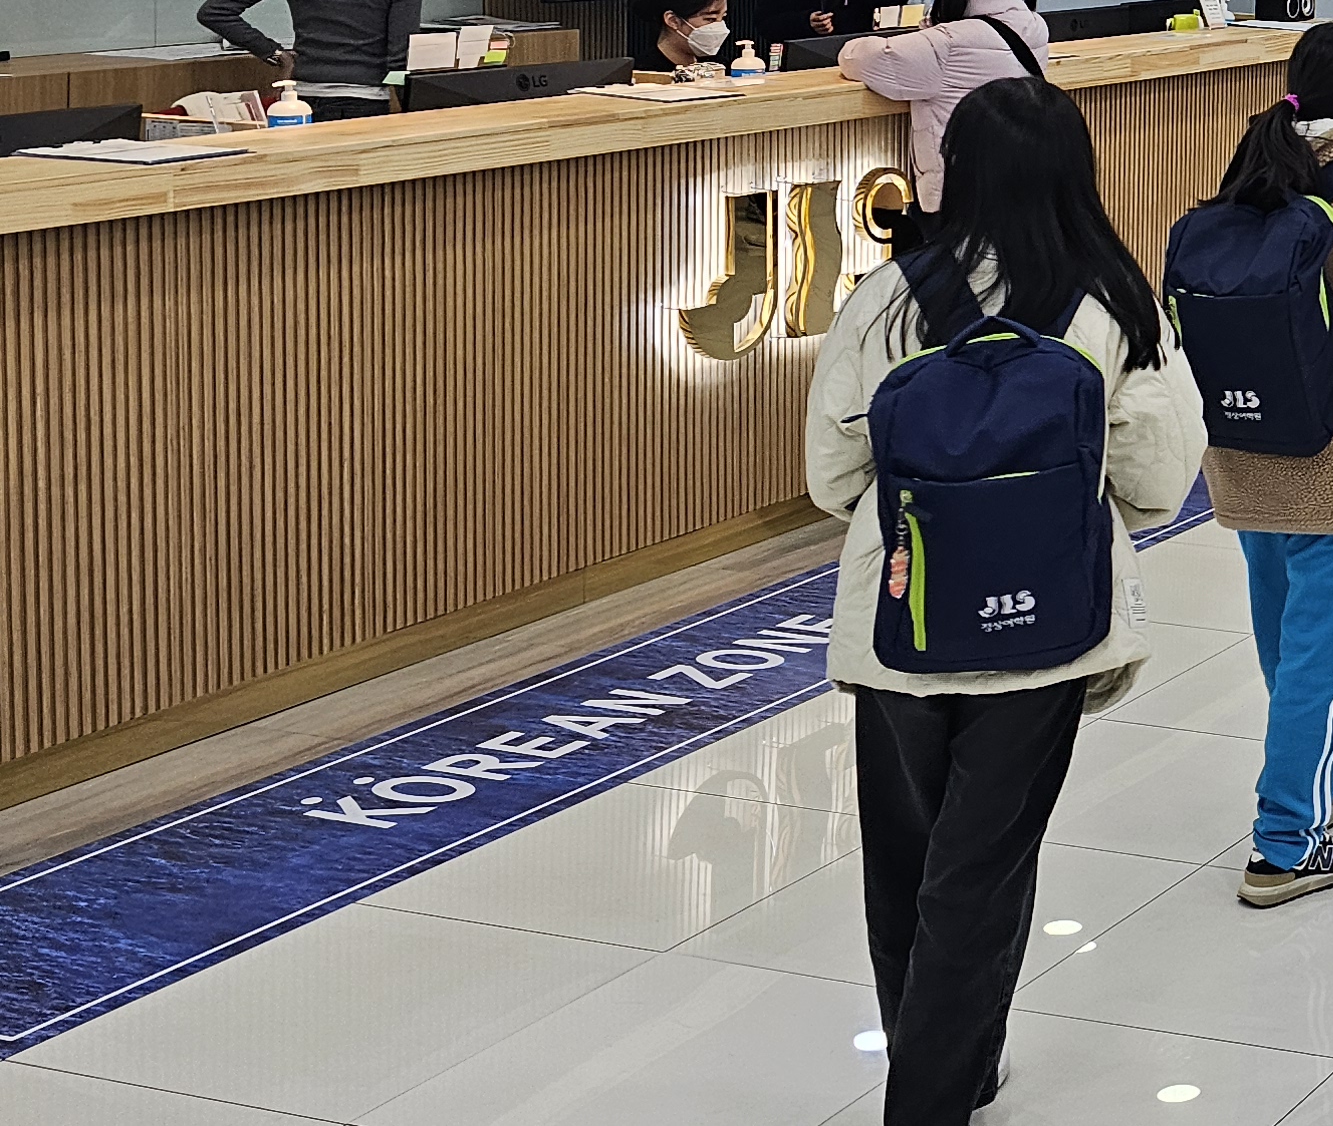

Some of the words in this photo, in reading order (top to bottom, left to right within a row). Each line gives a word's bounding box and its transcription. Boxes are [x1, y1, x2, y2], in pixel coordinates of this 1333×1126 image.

[531, 74, 549, 88] LG
[1221, 390, 1261, 409] JLS
[977, 589, 1036, 618] JLS
[302, 689, 694, 830] KOREAN
[648, 614, 834, 690] ZONE
